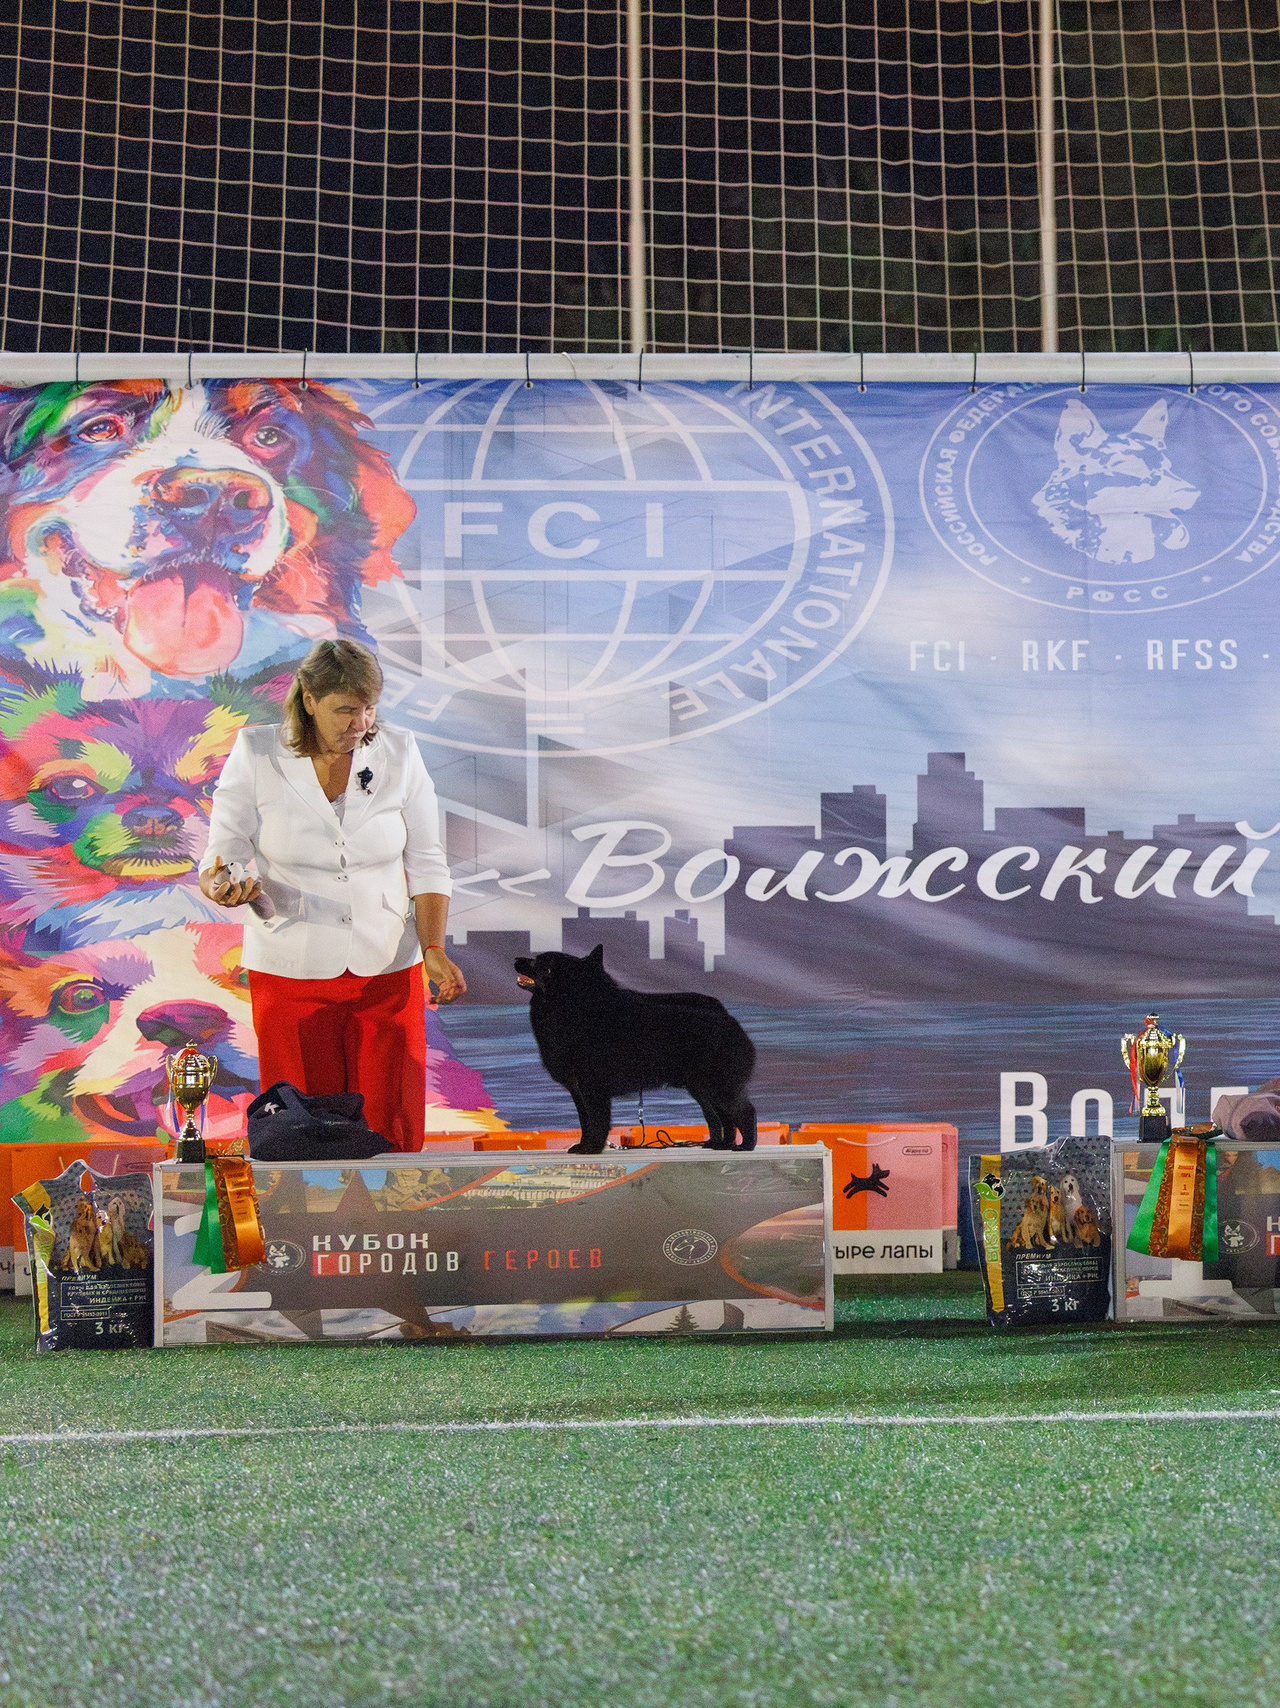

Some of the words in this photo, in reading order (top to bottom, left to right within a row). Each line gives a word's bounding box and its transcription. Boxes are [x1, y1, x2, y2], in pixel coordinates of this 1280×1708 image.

[934, 448, 999, 566] РОССИЙСКАЯ
[444, 501, 664, 559] FCI
[661, 381, 872, 722] INTERNATIONALE
[1066, 584, 1170, 605] РФСС
[909, 640, 966, 672] FCI
[1022, 639, 1090, 672] RKF
[1147, 638, 1238, 671] RFSS
[313, 1232, 430, 1252] КУБОК
[880, 1244, 933, 1259] лапы
[316, 1251, 460, 1277] ГОРОДОВ
[482, 1247, 603, 1271] ГЕРОЕВ
[1051, 1298, 1060, 1312] 3
[1064, 1300, 1080, 1311] кг
[95, 1321, 104, 1335] 3
